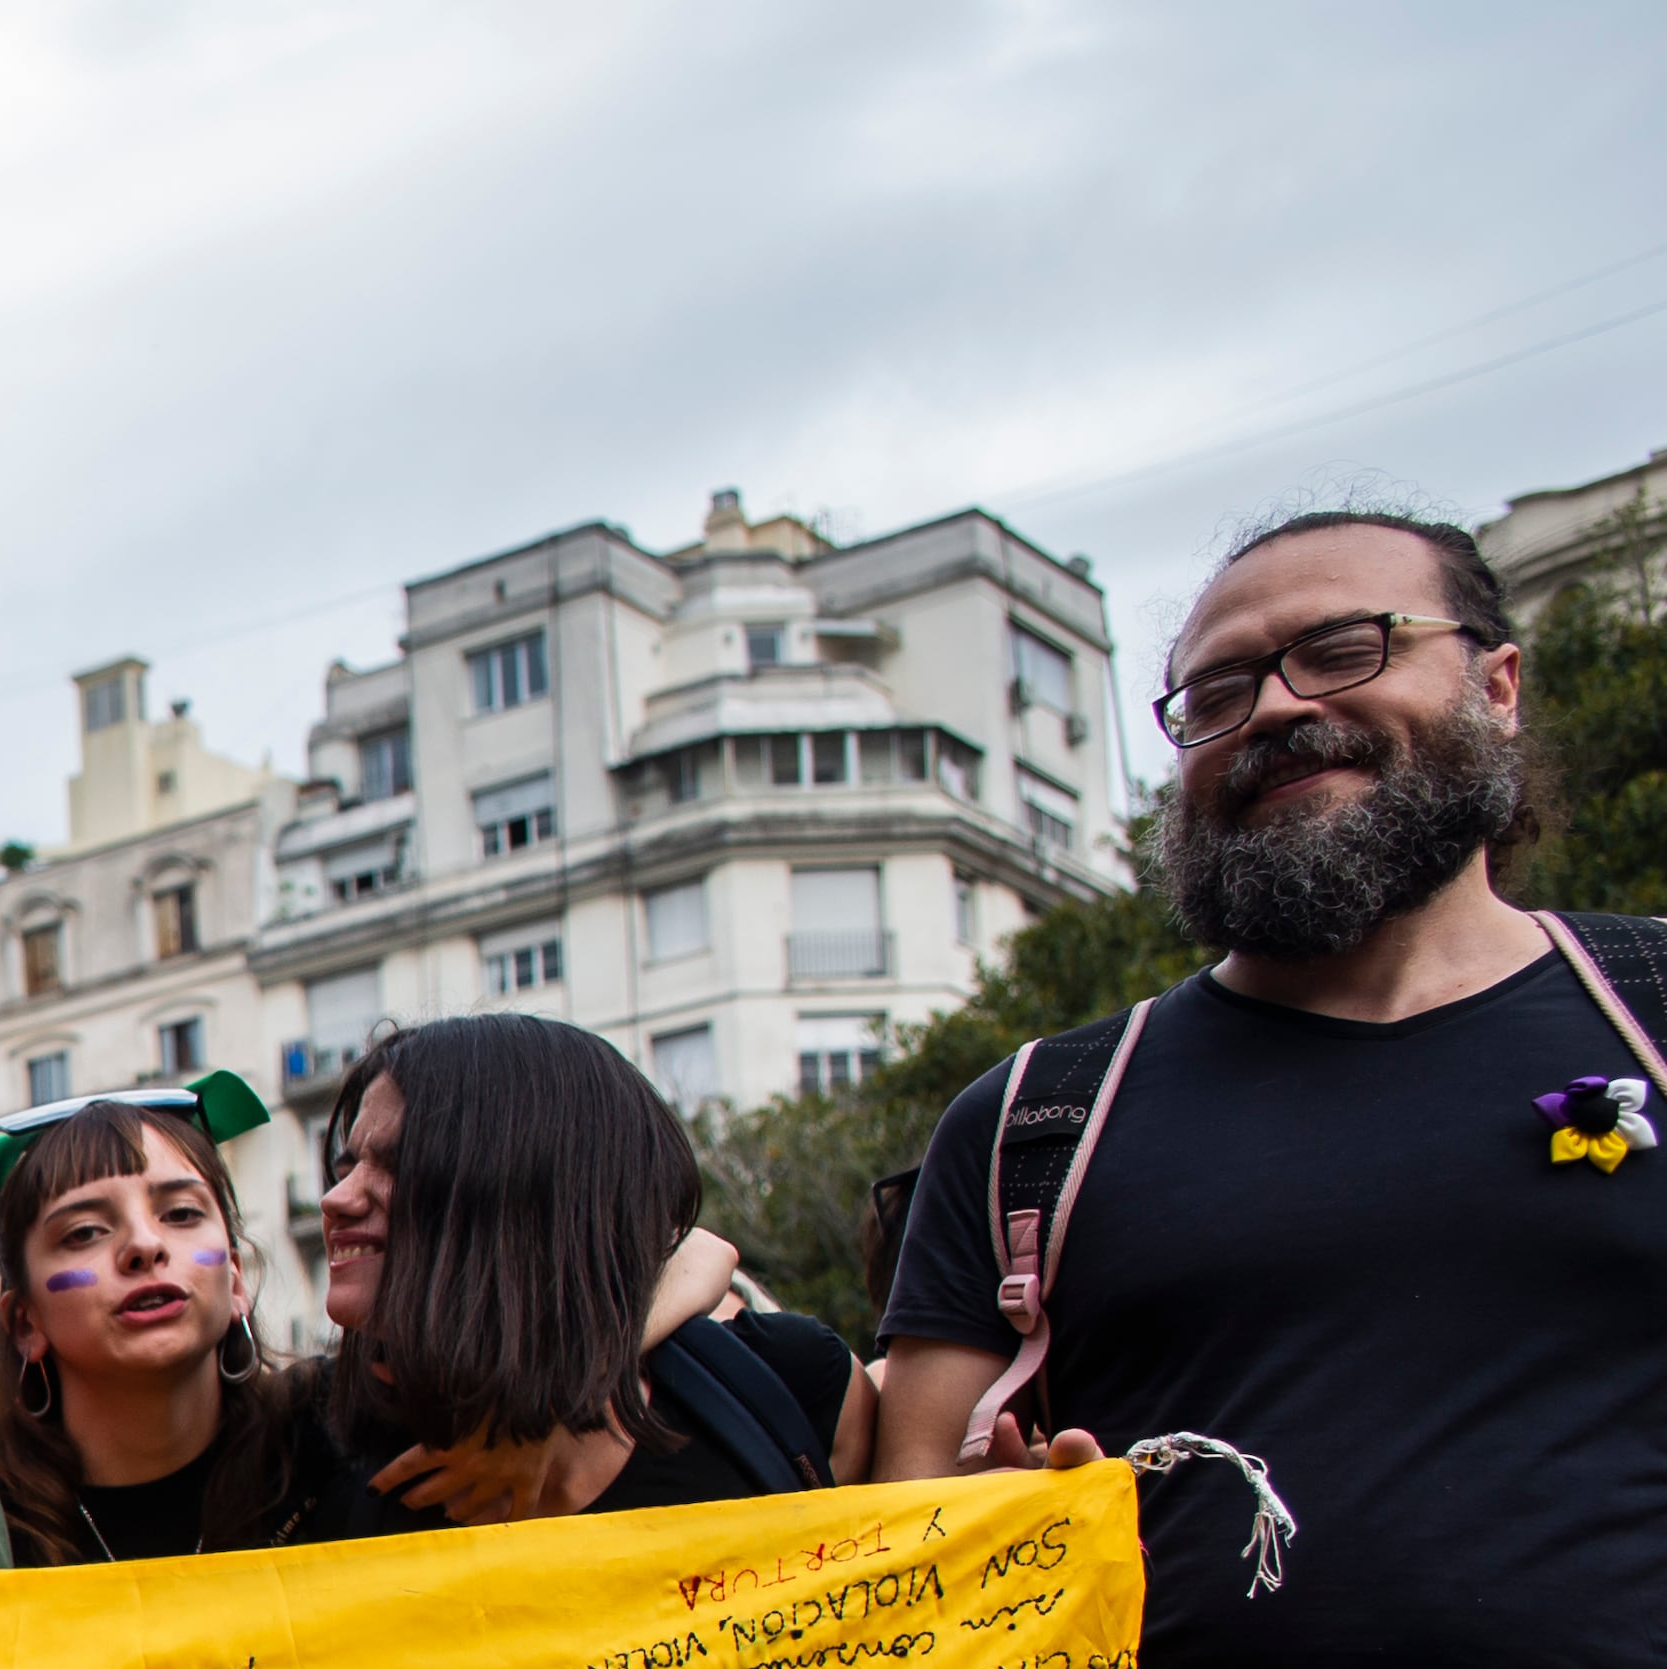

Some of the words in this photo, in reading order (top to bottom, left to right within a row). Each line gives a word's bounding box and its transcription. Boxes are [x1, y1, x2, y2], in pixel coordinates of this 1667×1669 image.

[1005, 1104, 1087, 1128] billabong
[922, 1506, 947, 1541] Y
[676, 1522, 891, 1611] TORTURA
[980, 1517, 1070, 1590] SON
[960, 1588, 1064, 1632] sin
